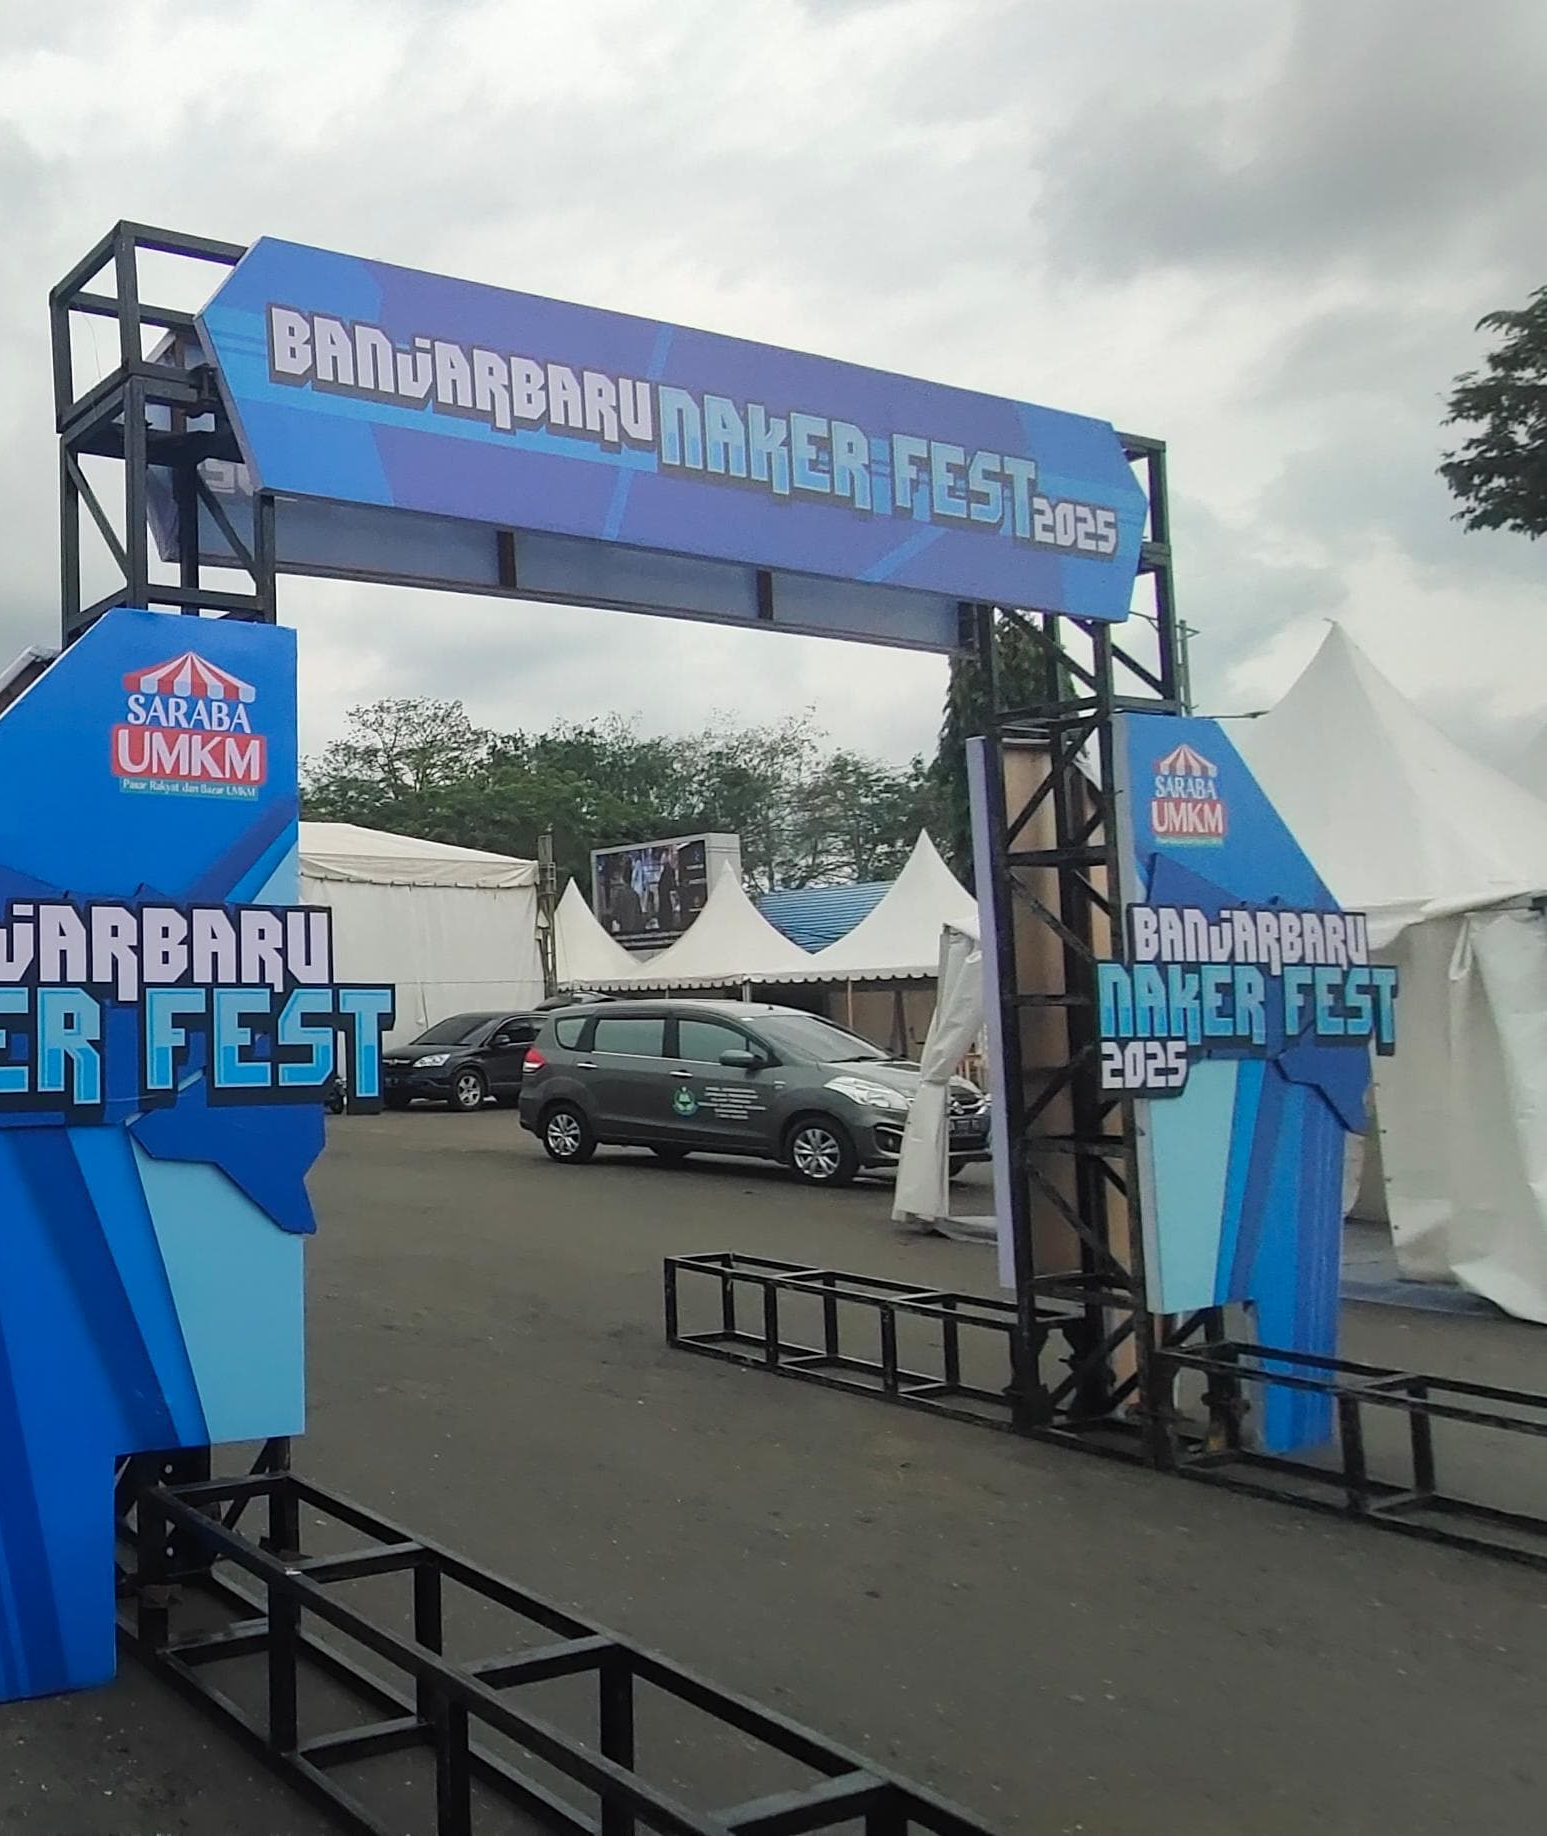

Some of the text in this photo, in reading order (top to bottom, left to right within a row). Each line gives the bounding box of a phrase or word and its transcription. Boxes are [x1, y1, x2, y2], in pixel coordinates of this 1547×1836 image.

[892, 433, 1036, 539] FEST
[1033, 497, 1119, 555] 2025
[127, 694, 252, 734] SARABA
[117, 728, 261, 782] UMKM
[149, 780, 180, 794] Rakyat
[182, 781, 199, 793] dan
[226, 785, 256, 797] UMKM
[1155, 775, 1218, 801] SARABA
[1151, 801, 1224, 834] UMKM
[1282, 965, 1397, 1045] FEST
[144, 987, 392, 1098] FEST
[1101, 1040, 1188, 1090] 2025
